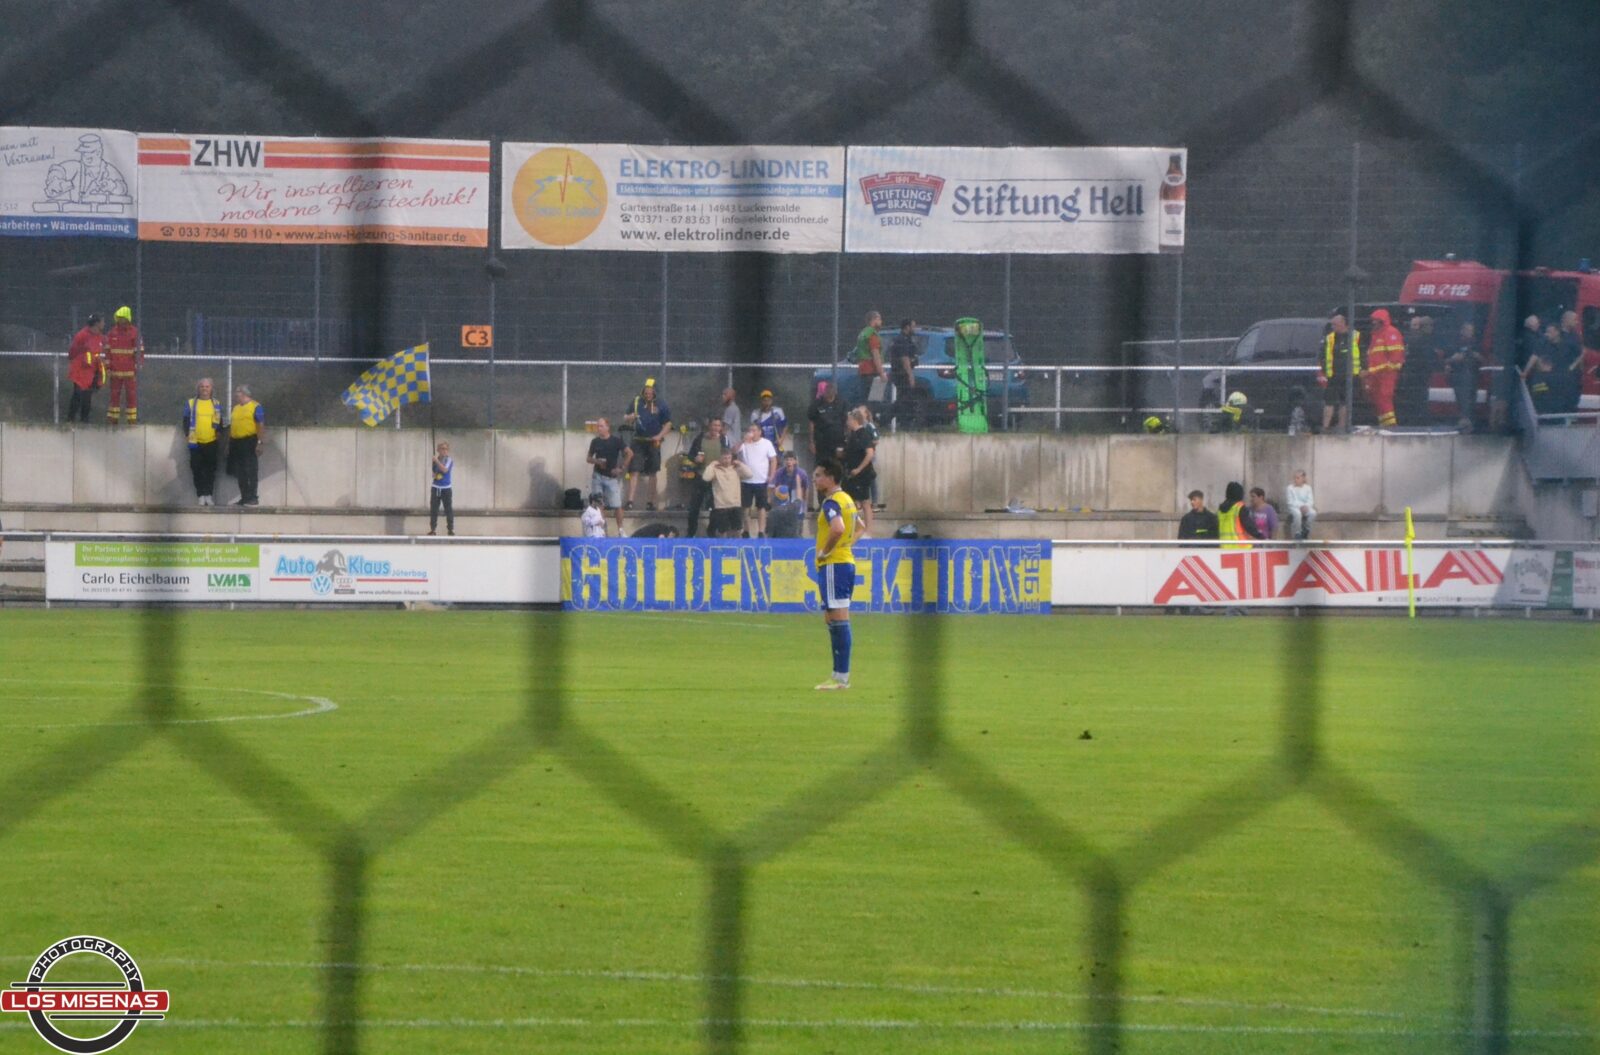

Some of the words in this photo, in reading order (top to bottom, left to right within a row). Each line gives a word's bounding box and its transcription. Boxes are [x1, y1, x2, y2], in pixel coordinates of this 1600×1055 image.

[194, 139, 261, 167] ZHW
[620, 158, 829, 179] ELEKTRO-LINDNER
[217, 179, 277, 202] Wir
[284, 174, 412, 199] installieren
[872, 189, 933, 202] STIFTUNGS
[220, 200, 321, 222] moderne
[327, 187, 478, 215] Heiztechnik!
[620, 203, 683, 213] Gartenstraße
[686, 204, 697, 213] 14
[709, 204, 736, 213] 14943
[739, 203, 801, 213] Luckenwalde
[951, 183, 1082, 223] Stiftung
[1089, 184, 1145, 216] Hell
[634, 215, 662, 224] 03371
[880, 216, 922, 227] ERDING
[50, 220, 130, 234] Wärmedämmung
[178, 226, 200, 238] 033
[233, 227, 248, 239] 50
[252, 228, 272, 239] 110
[664, 227, 791, 241] elektrolindner.de
[465, 330, 489, 346] C3
[276, 555, 315, 575] Auto
[347, 555, 391, 575] Klaus
[82, 572, 115, 584] Carlo
[119, 572, 190, 585] Eichelbaum
[207, 573, 237, 586] LVM
[570, 545, 773, 613] GOLDEN
